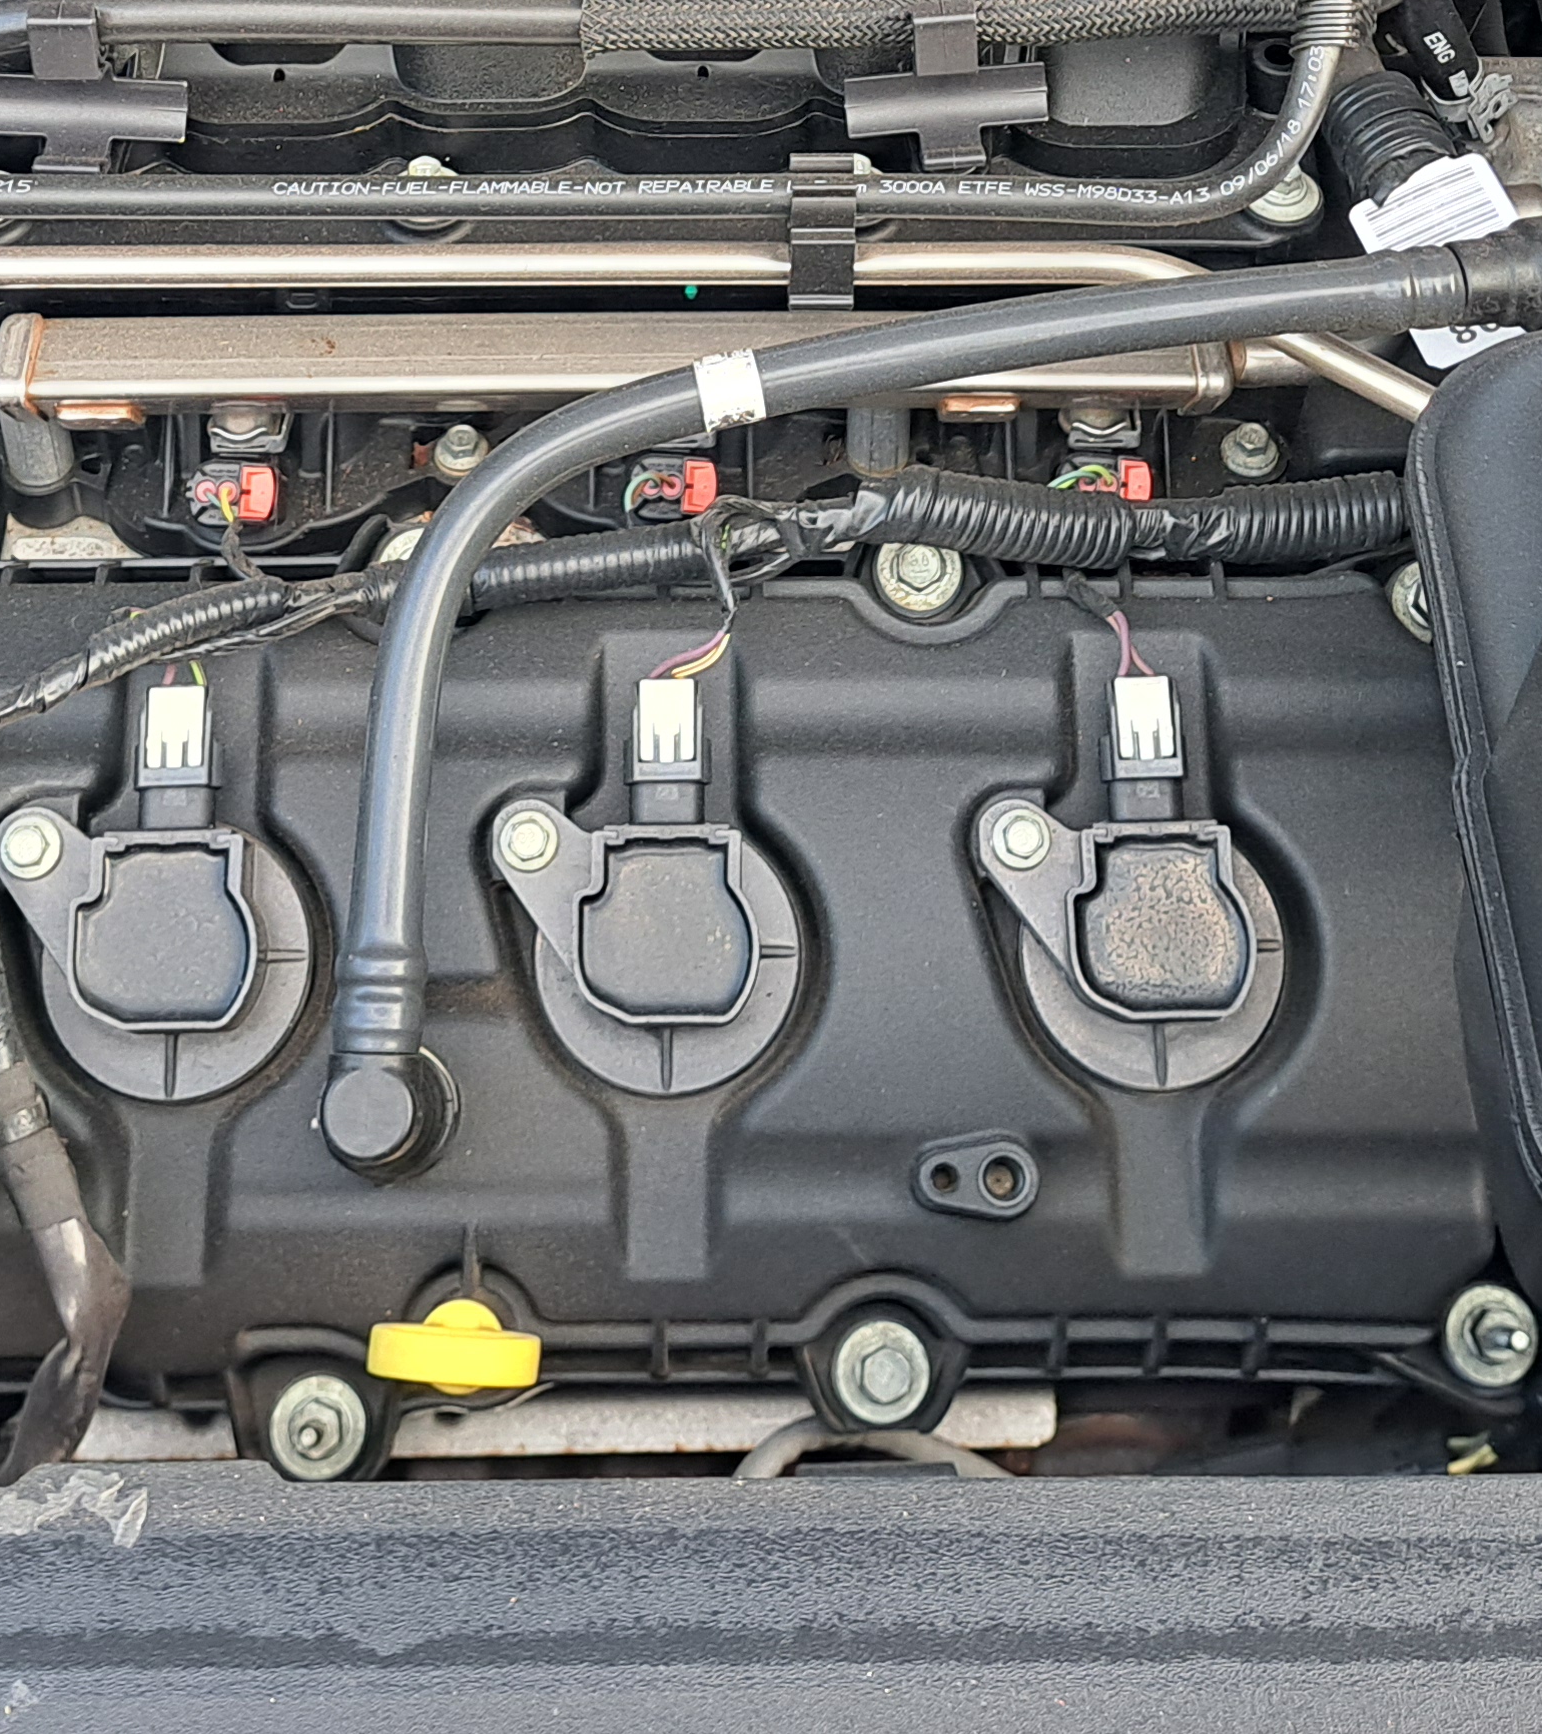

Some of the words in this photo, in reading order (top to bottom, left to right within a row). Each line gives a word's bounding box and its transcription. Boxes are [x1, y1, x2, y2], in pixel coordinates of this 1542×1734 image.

[1423, 31, 1455, 64] ENG
[271, 180, 627, 196] CAUTION-FUEL-FLAMMABLE-NOT
[638, 179, 774, 195] REPAIRABLE
[878, 181, 946, 195] 3000A
[957, 181, 1013, 196] ETFE
[1024, 182, 1210, 205] WSS-M98D33-A13
[1220, 118, 1302, 196] 09/06/18
[1297, 46, 1325, 110] 17:03
